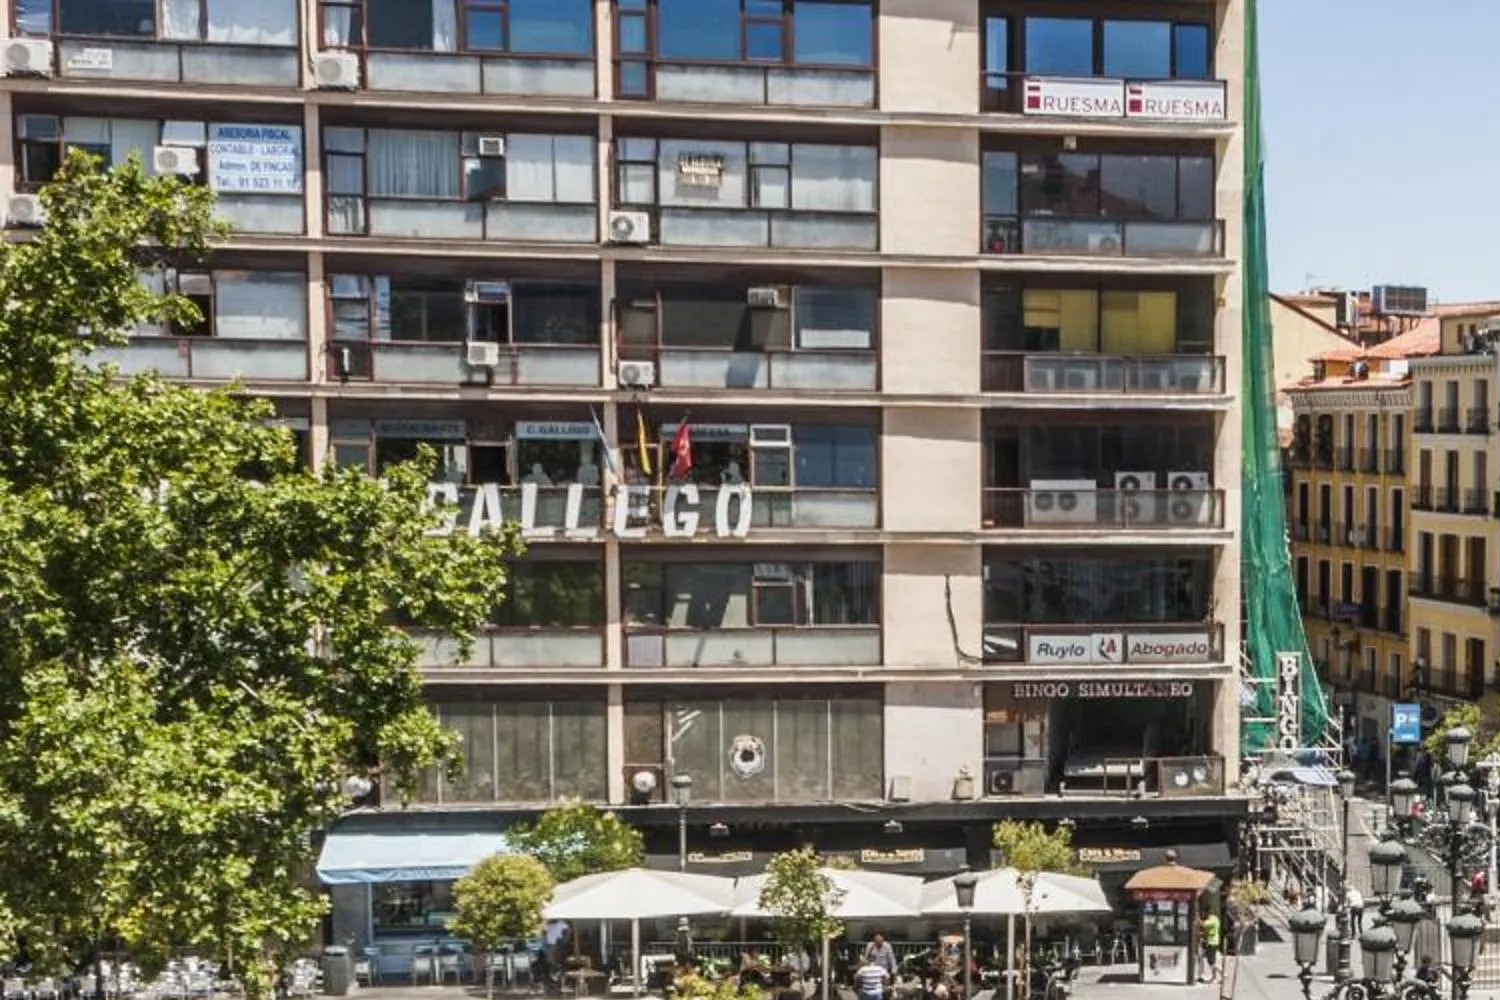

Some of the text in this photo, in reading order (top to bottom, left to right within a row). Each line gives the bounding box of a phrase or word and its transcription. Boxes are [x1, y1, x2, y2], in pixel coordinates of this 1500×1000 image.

[1043, 96, 1121, 113] RUESMA
[1145, 99, 1222, 115] RUESMA
[421, 482, 753, 537] GALLEGO
[1013, 682, 1193, 698] BINGO SIMULTANEO
[1279, 656, 1298, 754] BINGO
